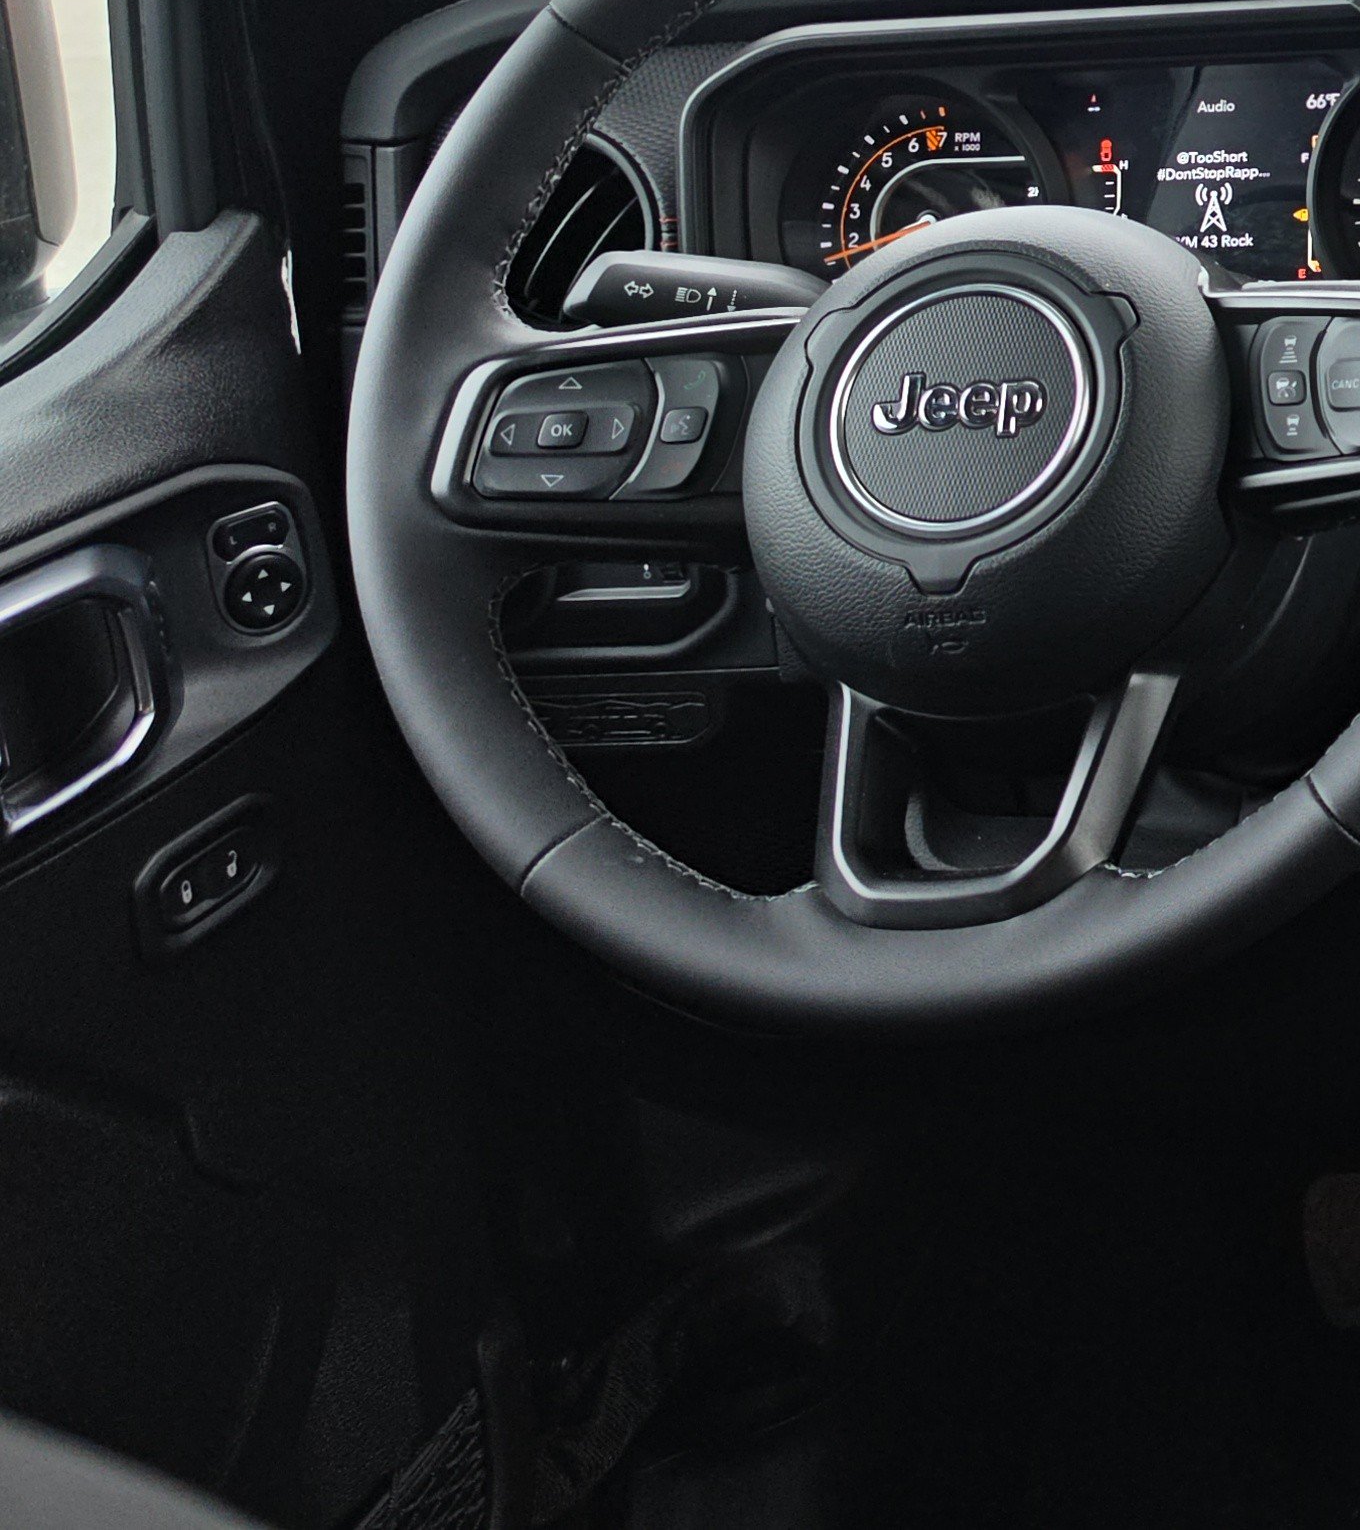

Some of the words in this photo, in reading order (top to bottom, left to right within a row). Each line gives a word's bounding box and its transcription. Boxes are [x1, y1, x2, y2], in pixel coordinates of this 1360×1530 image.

[1198, 100, 1235, 113] Audio
[938, 132, 947, 147] 7
[955, 133, 980, 142] RPM
[908, 138, 919, 152] 6
[881, 152, 892, 167] 5
[1177, 151, 1248, 164] @TooShort
[1301, 154, 1309, 163] F
[1120, 160, 1128, 170] H
[860, 175, 871, 190] 4
[850, 204, 860, 219] 3
[848, 232, 859, 247] 2
[1201, 235, 1218, 248] 43
[1222, 234, 1253, 247] Rock
[1298, 269, 1306, 278] E
[1332, 379, 1360, 389] CANC
[872, 372, 1048, 438] Jeep
[550, 422, 573, 439] OK
